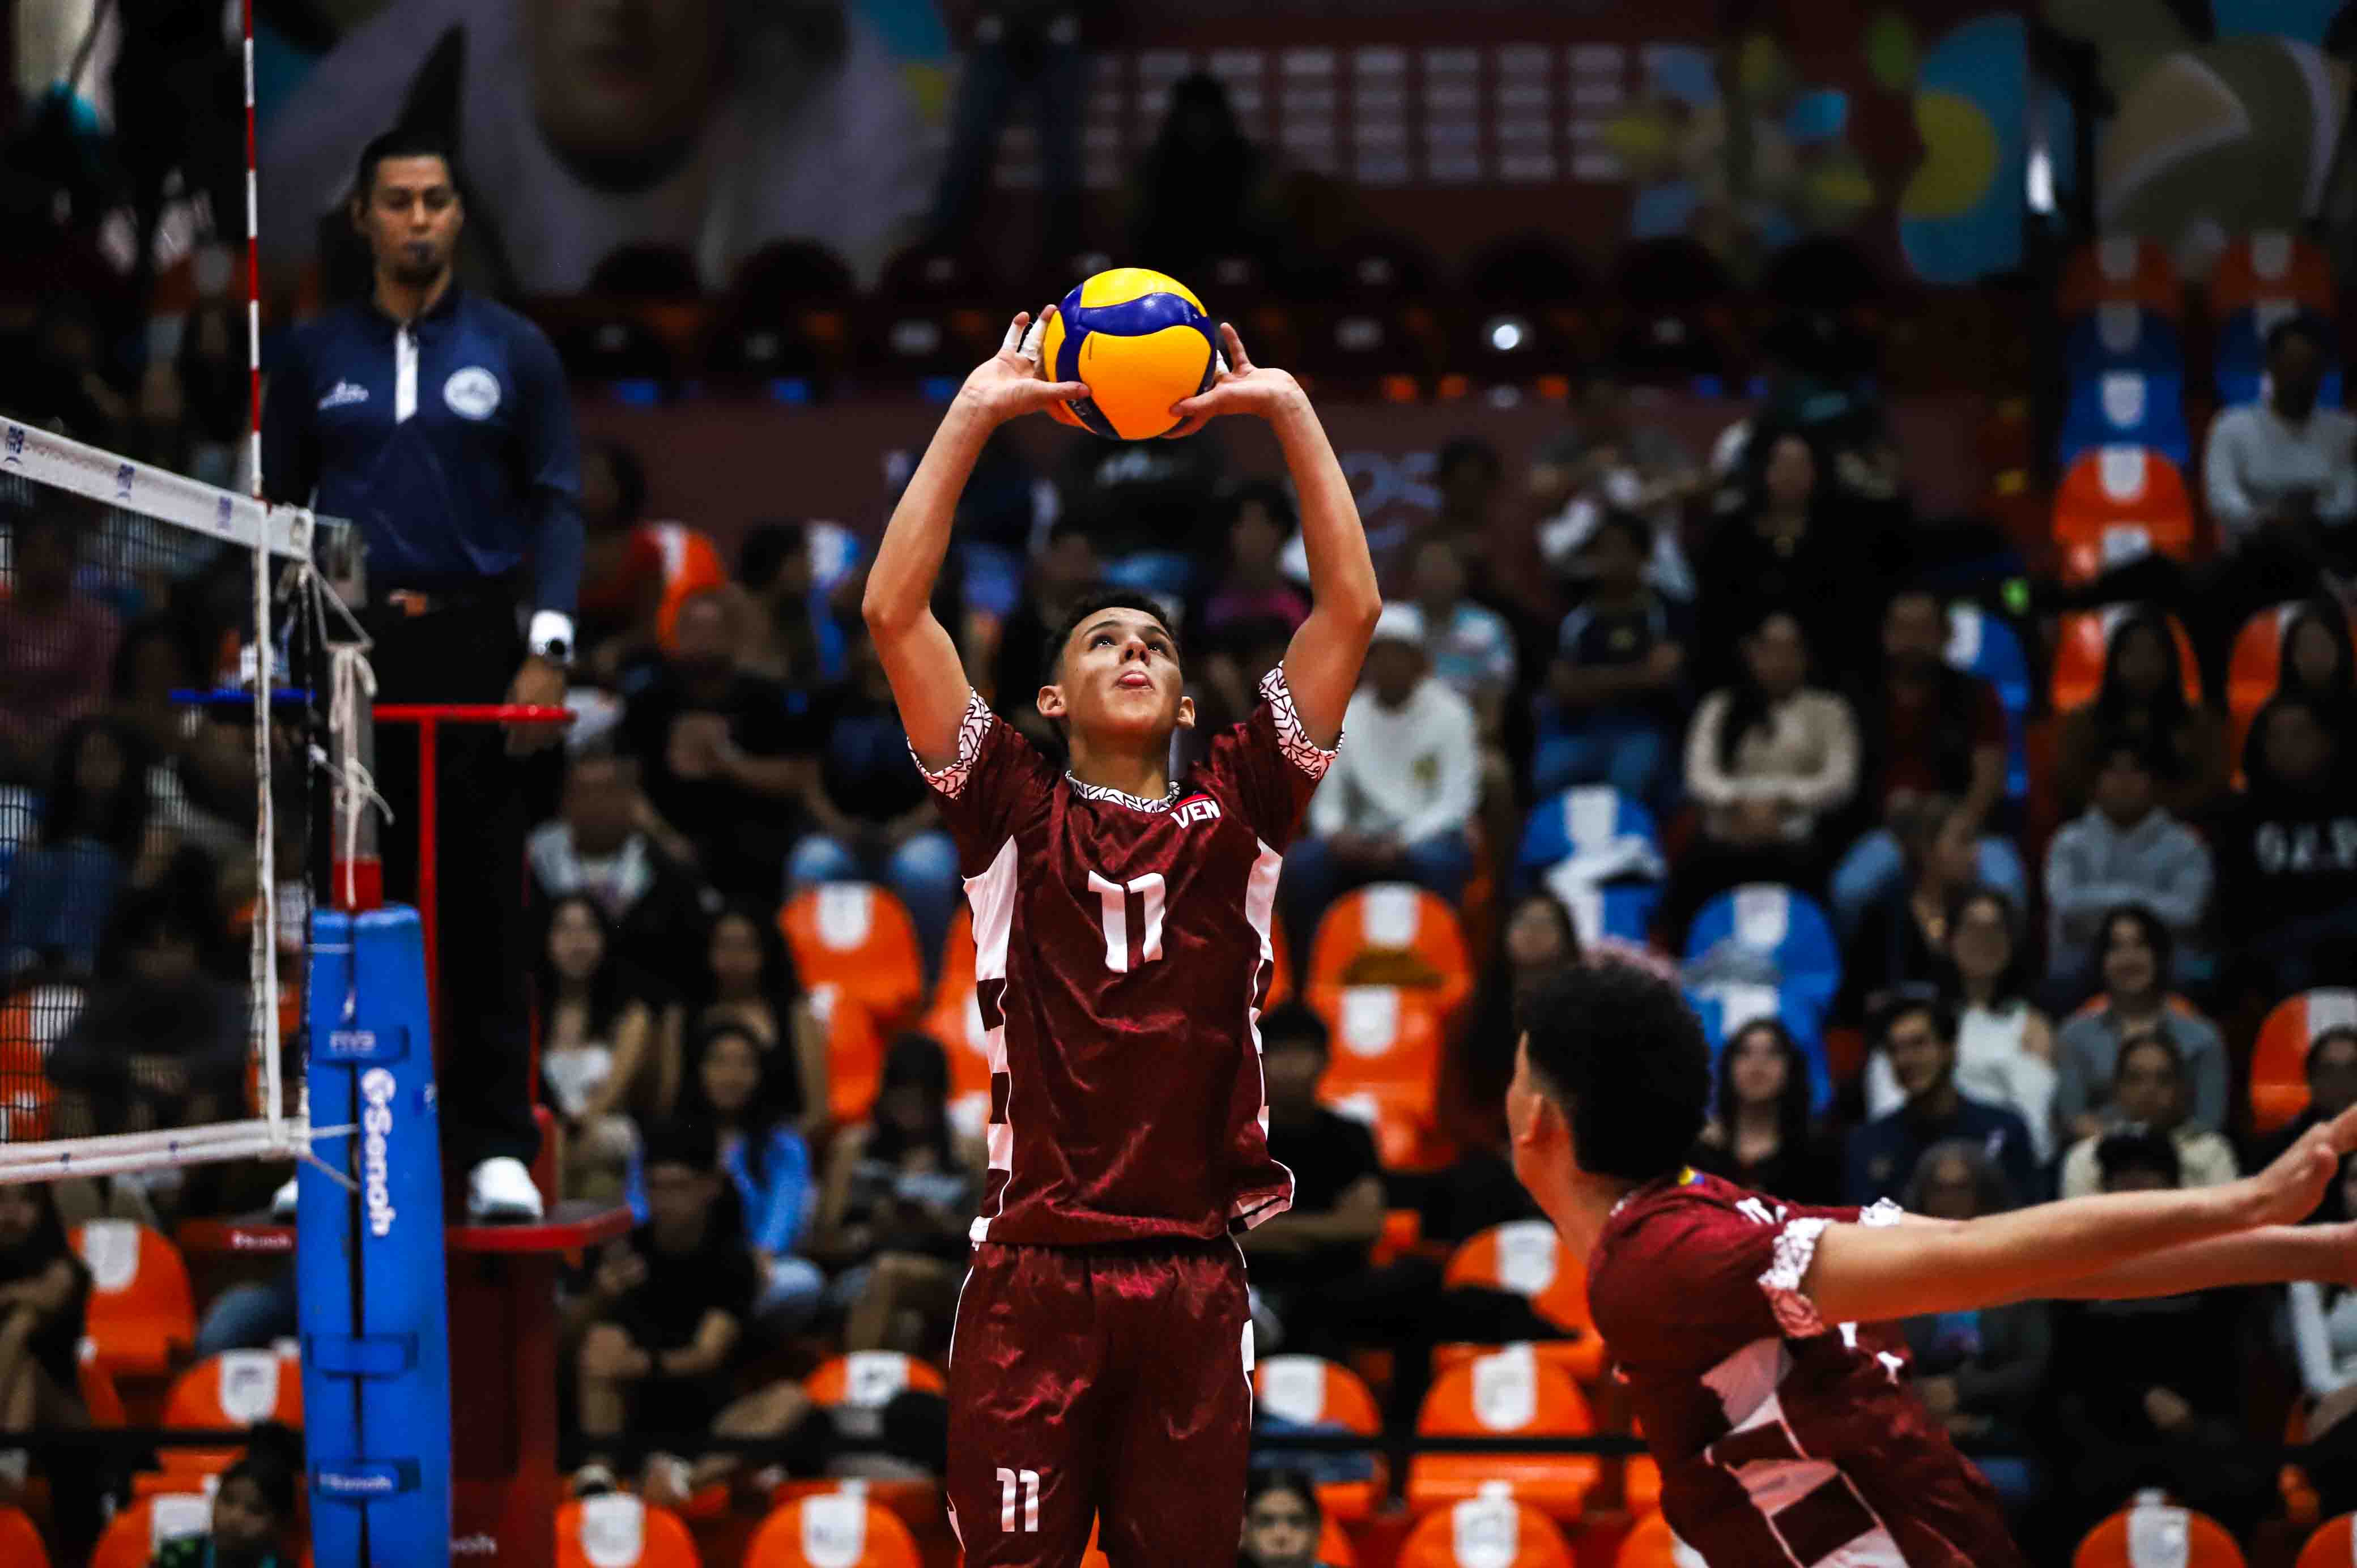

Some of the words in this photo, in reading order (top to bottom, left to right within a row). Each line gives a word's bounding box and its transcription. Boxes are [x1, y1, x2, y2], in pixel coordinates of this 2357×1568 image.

[1169, 799, 1221, 829] VEN
[1088, 870, 1167, 973] 11
[364, 1105, 397, 1237] Senoh
[997, 1467, 1040, 1532] 11
